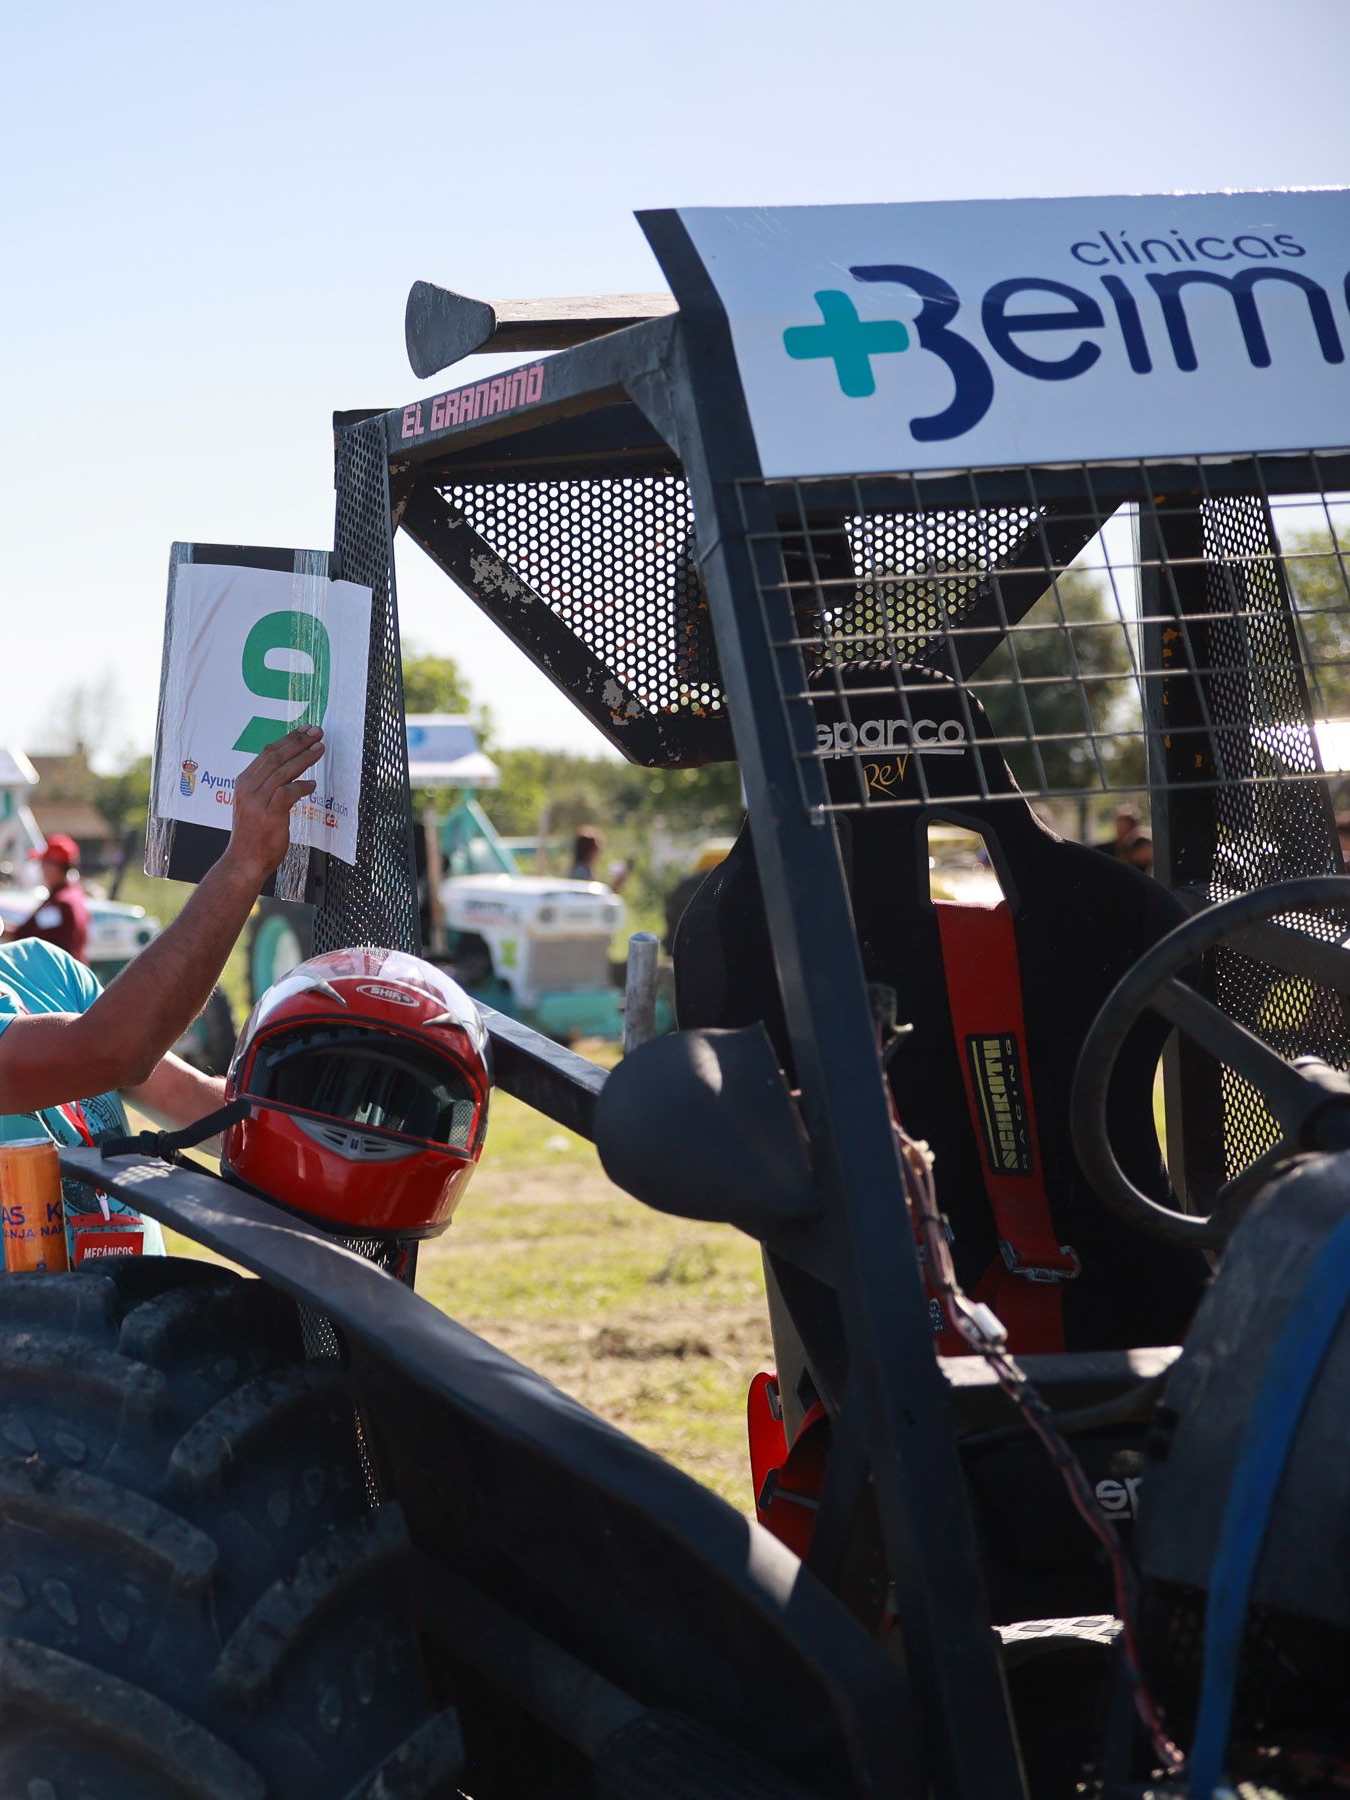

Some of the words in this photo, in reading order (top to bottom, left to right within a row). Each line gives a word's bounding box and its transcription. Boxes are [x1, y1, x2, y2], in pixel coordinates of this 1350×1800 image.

[1070, 229, 1307, 266] clínicas
[848, 262, 1350, 443] Beim
[401, 403, 425, 439] EL
[231, 609, 331, 755] 9
[982, 1039, 1019, 1169] SCHROTH
[83, 1244, 134, 1260] MECÁNICOS
